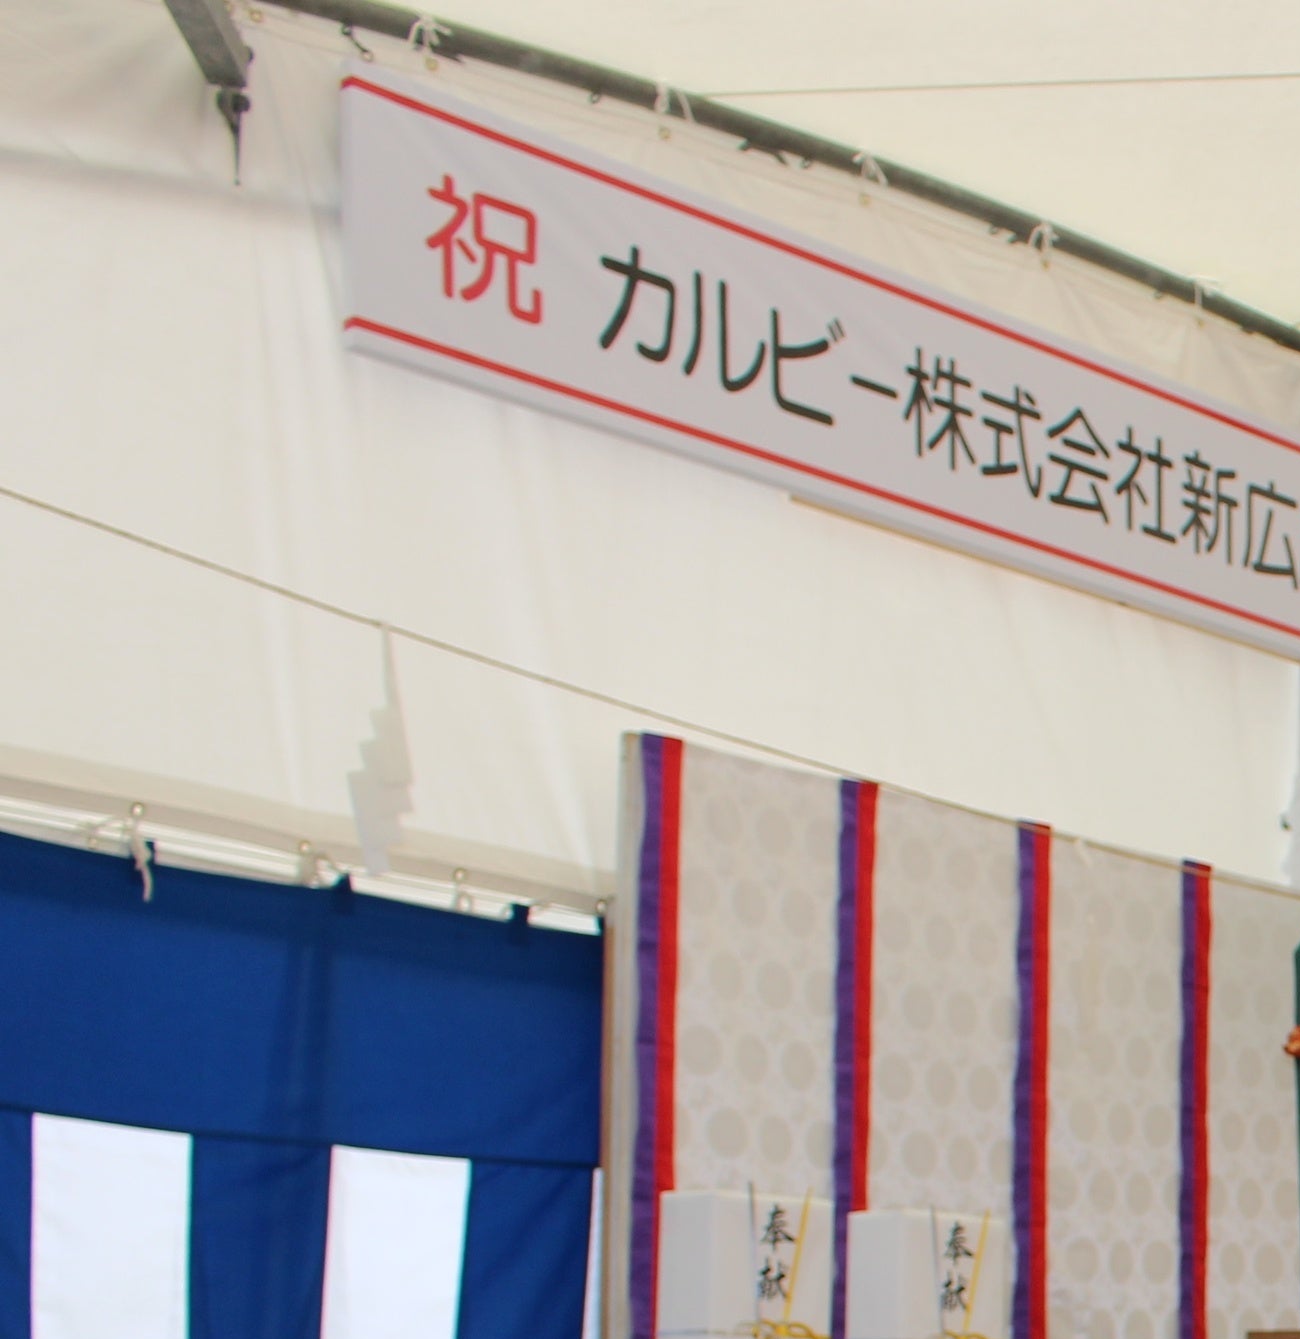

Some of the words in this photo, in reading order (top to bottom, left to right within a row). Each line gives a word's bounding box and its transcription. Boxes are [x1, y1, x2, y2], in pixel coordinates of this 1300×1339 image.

[424, 173, 544, 326] 祝
[757, 1203, 794, 1300] 奉献
[940, 1220, 973, 1313] 奉献
